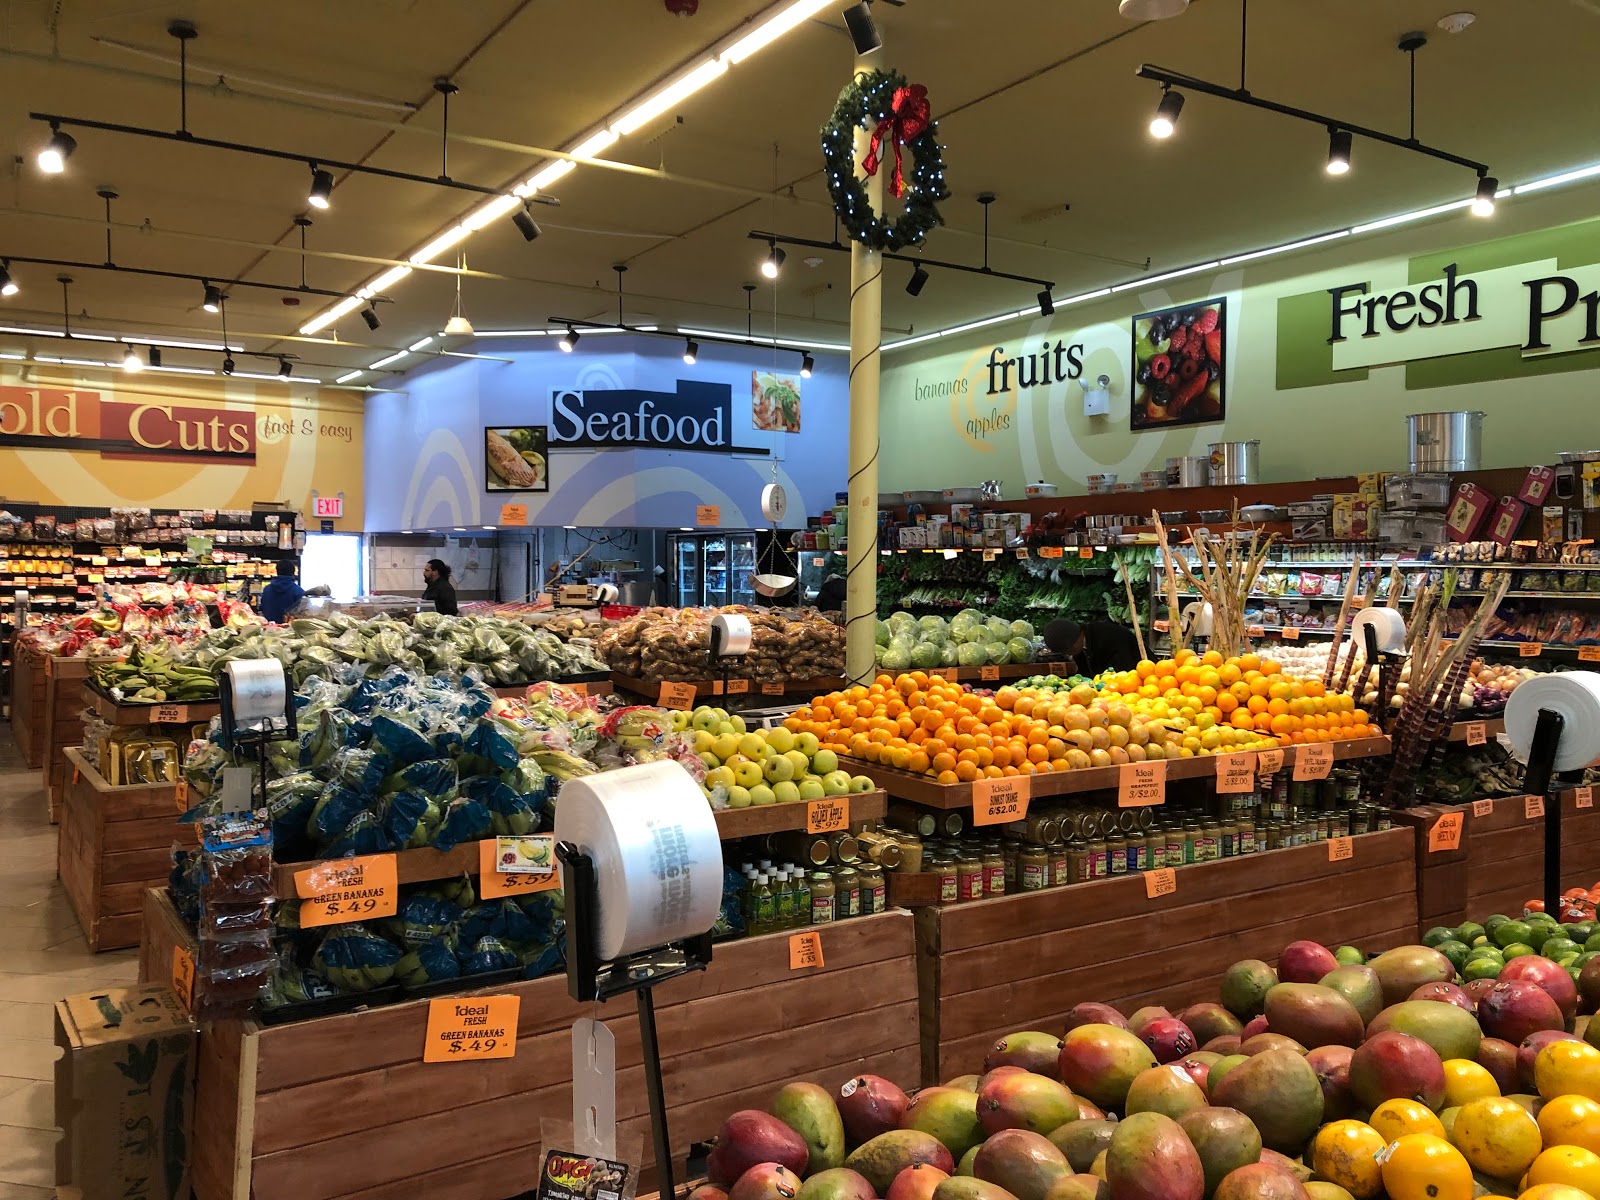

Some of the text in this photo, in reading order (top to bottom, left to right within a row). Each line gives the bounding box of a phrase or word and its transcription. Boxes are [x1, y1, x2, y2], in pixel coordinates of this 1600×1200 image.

[1327, 262, 1482, 343] Fresh
[987, 340, 1084, 395] fruits
[915, 378, 968, 402] bananas
[128, 404, 250, 454] Cuts
[264, 414, 353, 443] fast & easy
[551, 390, 726, 447] Seafood
[966, 408, 1010, 439] apples
[317, 499, 342, 516] EXIT
[988, 804, 1017, 816] 6/$2.00
[313, 887, 385, 905] GREEN BANANAS
[325, 899, 378, 916] $.49
[455, 1005, 489, 1017] ideal
[463, 1016, 488, 1026] FRESH
[440, 1028, 505, 1041] GREEN BANANAS
[447, 1039, 497, 1054] $.49
[548, 1155, 596, 1182] OMG!
